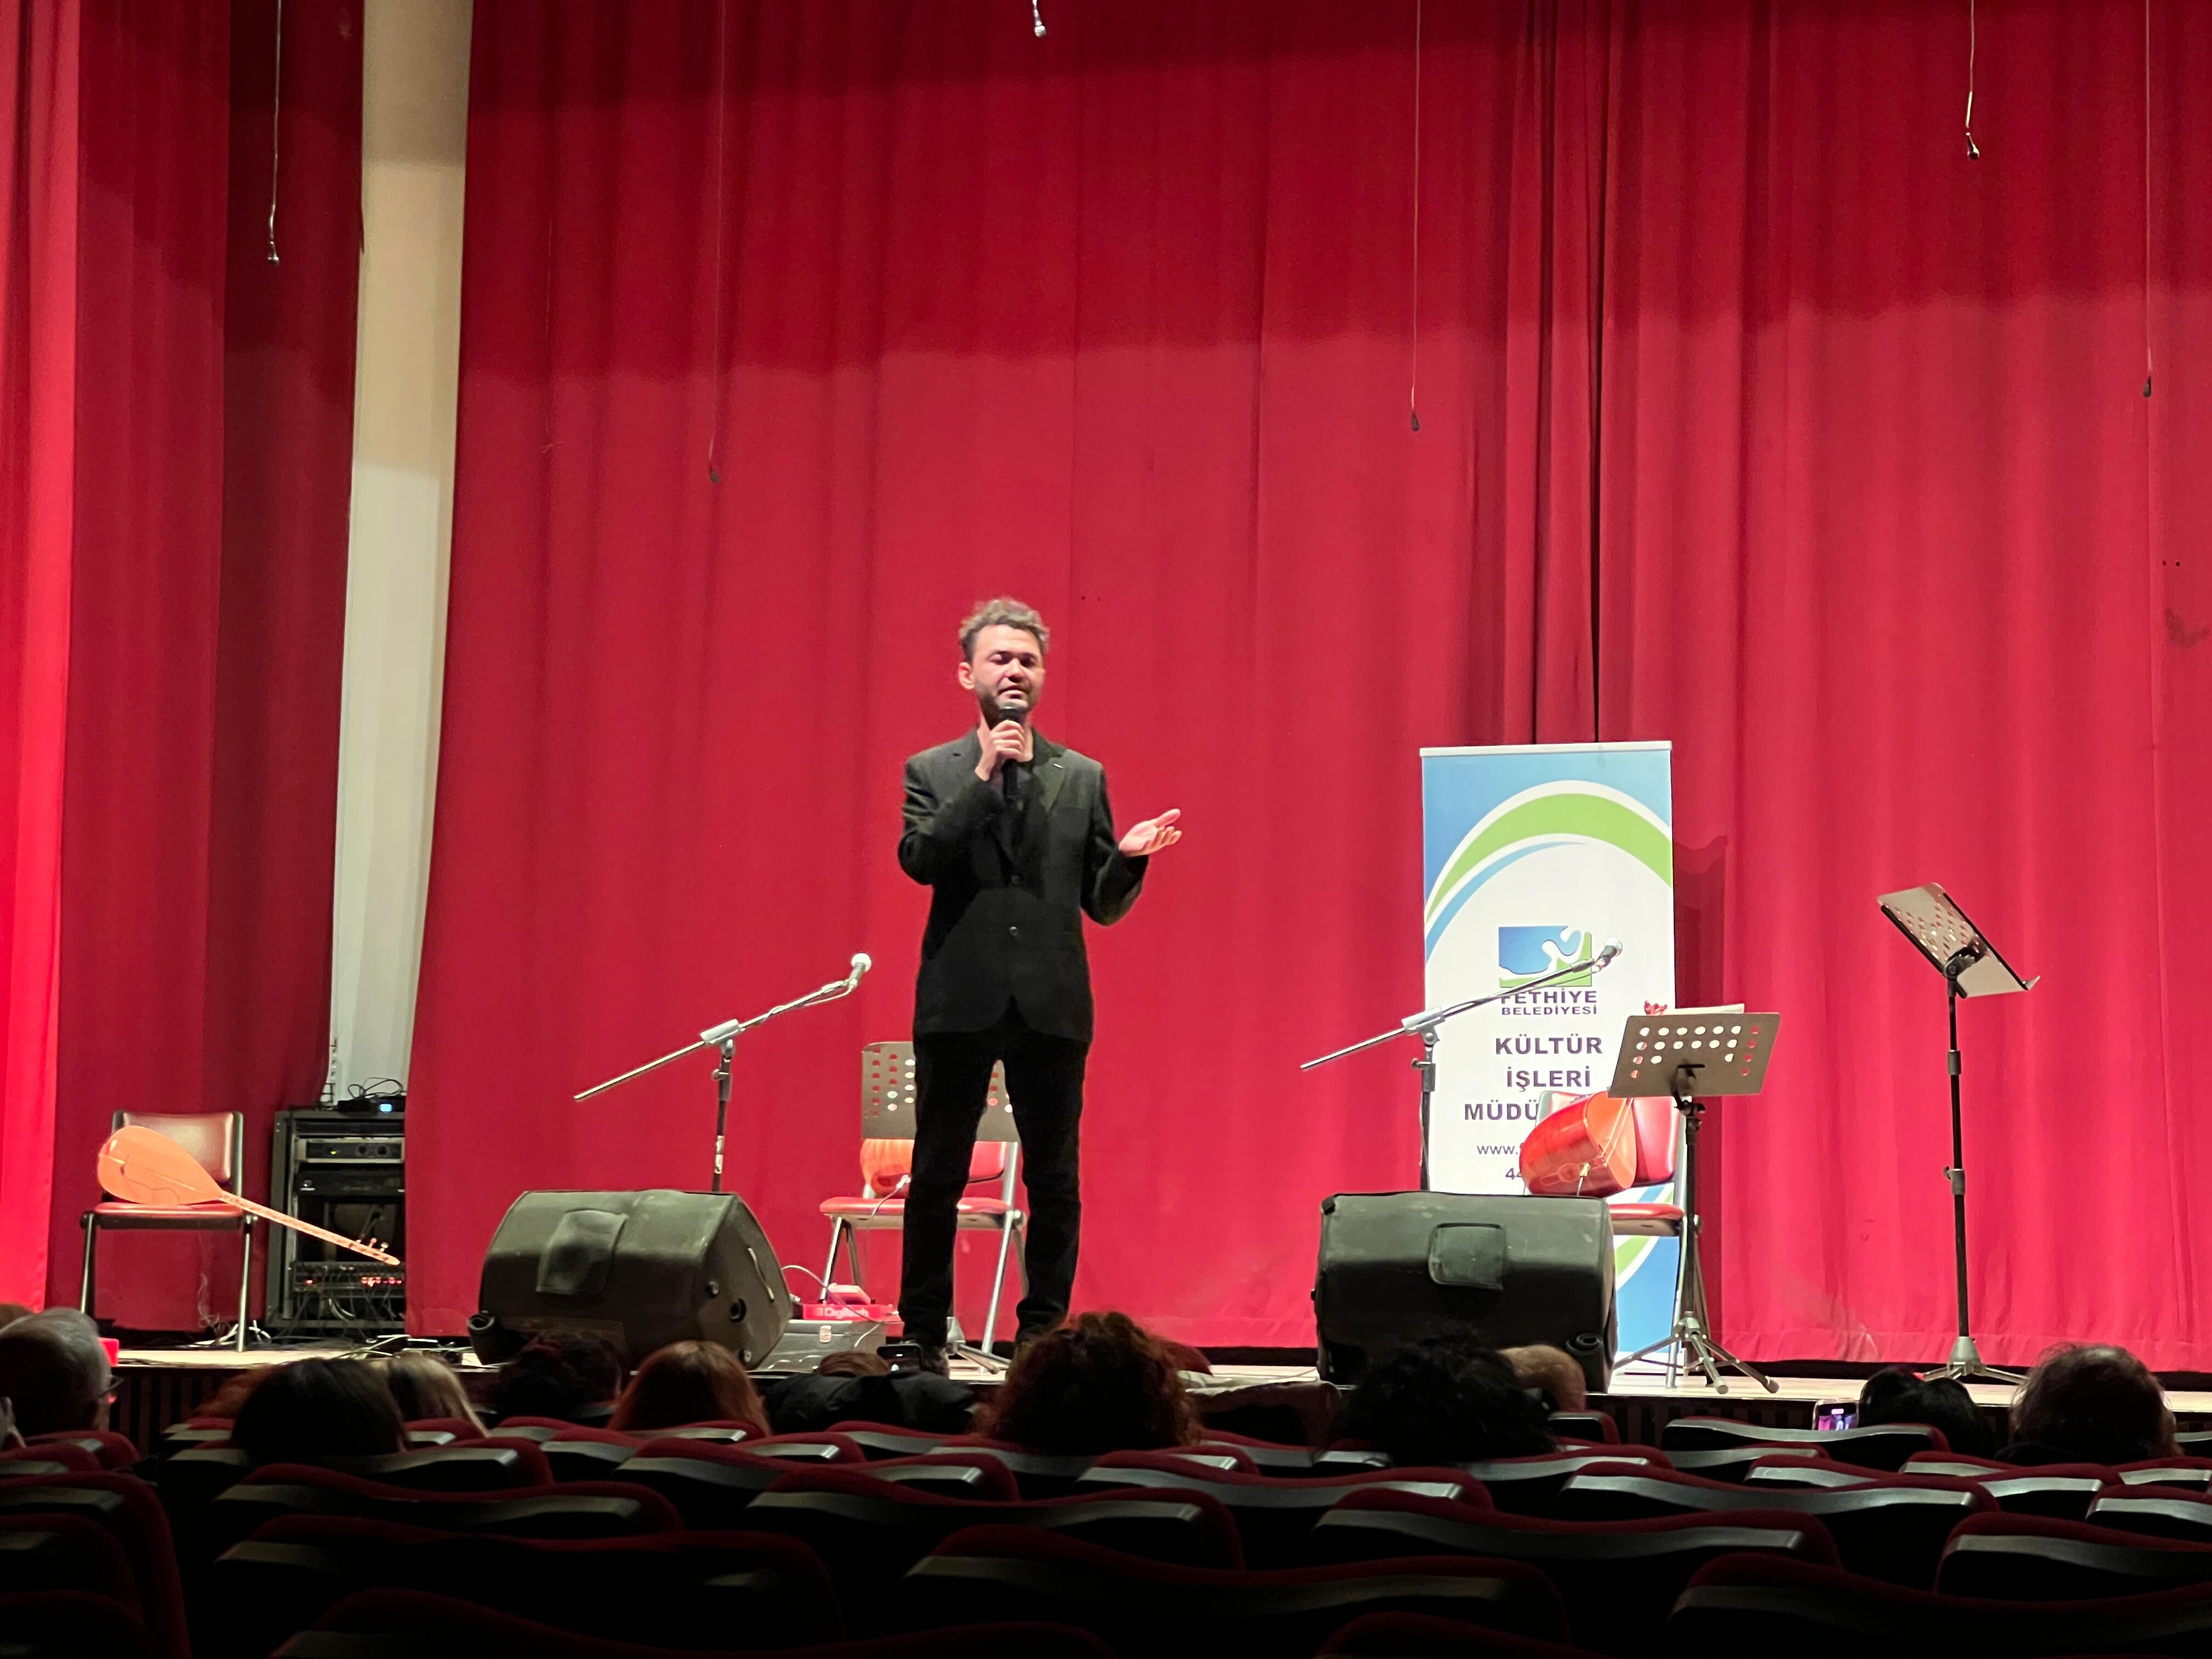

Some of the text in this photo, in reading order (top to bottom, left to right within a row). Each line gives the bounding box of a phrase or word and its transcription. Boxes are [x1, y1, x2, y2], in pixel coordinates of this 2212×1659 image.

[1502, 1005, 1597, 1015] BELEDİYESİ
[1496, 1033, 1602, 1054] KÜLTÜR
[1507, 1065, 1590, 1092] İŞLERİ
[1464, 1099, 1538, 1120] MÜDÜ
[1477, 1145, 1518, 1155] www.
